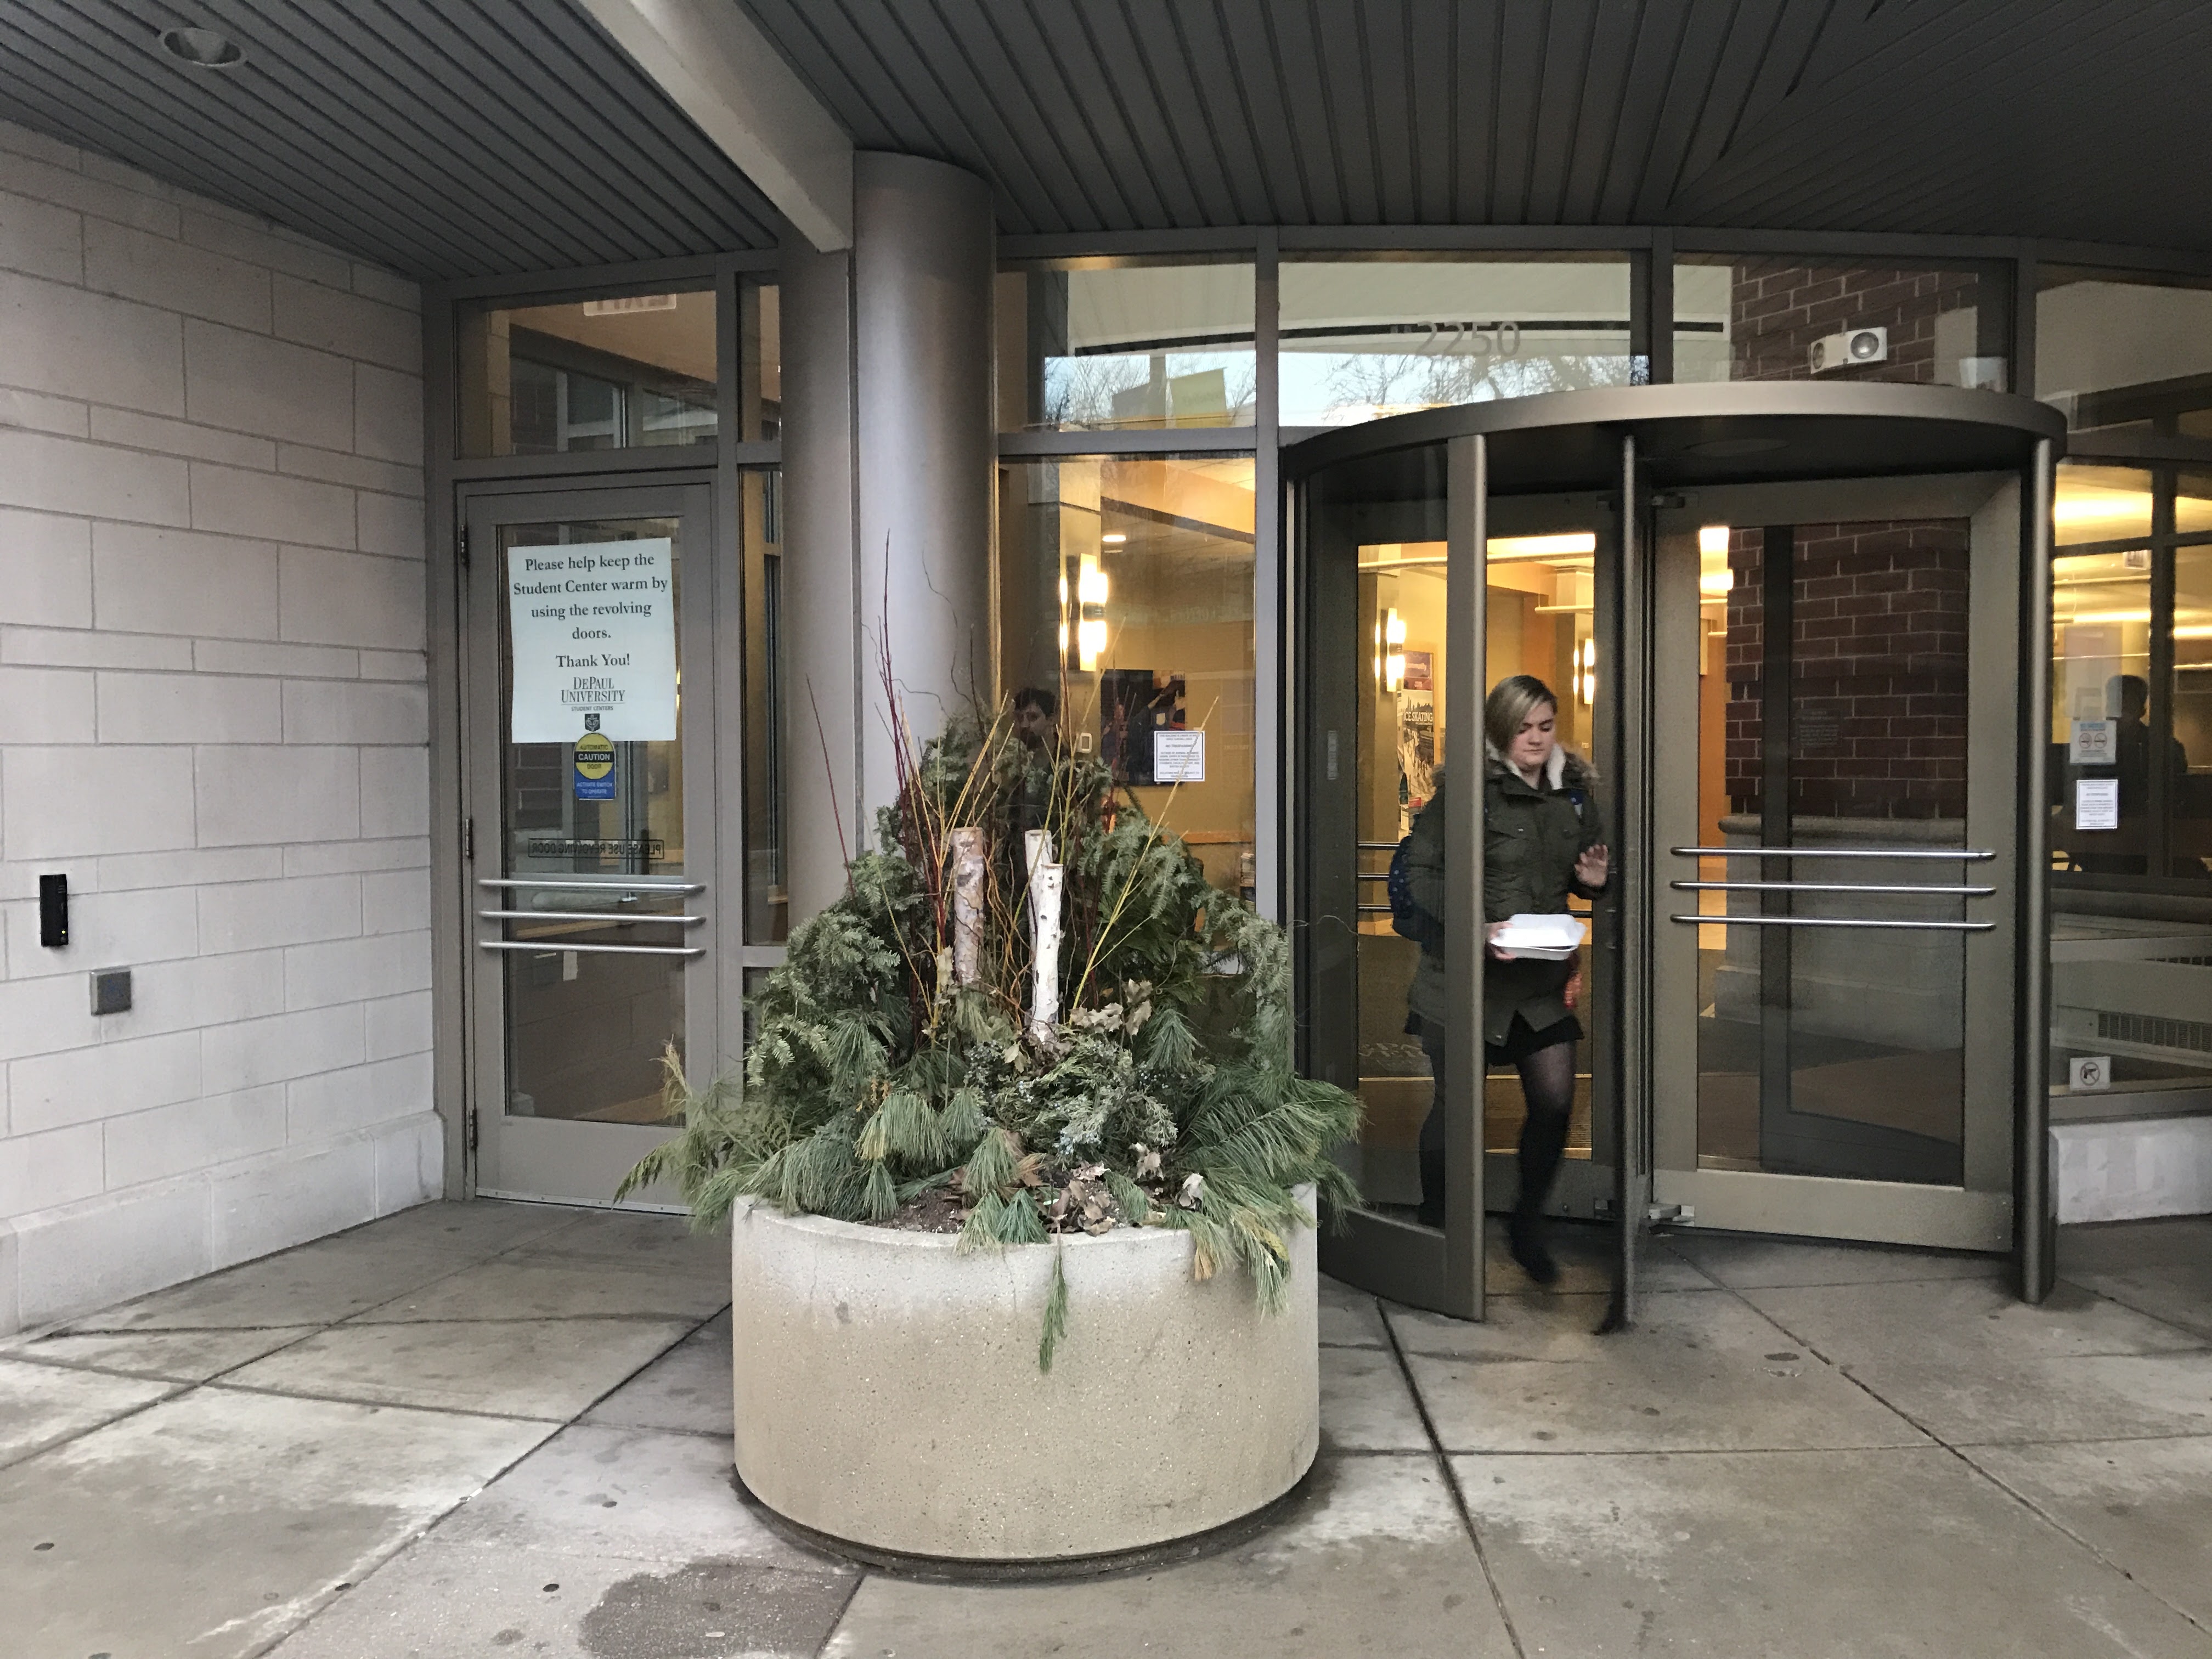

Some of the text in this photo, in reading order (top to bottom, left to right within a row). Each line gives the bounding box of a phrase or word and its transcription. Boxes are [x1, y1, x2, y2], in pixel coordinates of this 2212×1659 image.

[1415, 320, 1520, 357] 2250
[525, 554, 654, 572] Please help keep the
[514, 577, 668, 595] Student Center warm by
[531, 601, 652, 620] using the revolving
[572, 627, 611, 639] doors.
[555, 653, 630, 667] Thank You!
[561, 690, 625, 703] UNIVERSITY
[1412, 712, 1433, 722] SKATING
